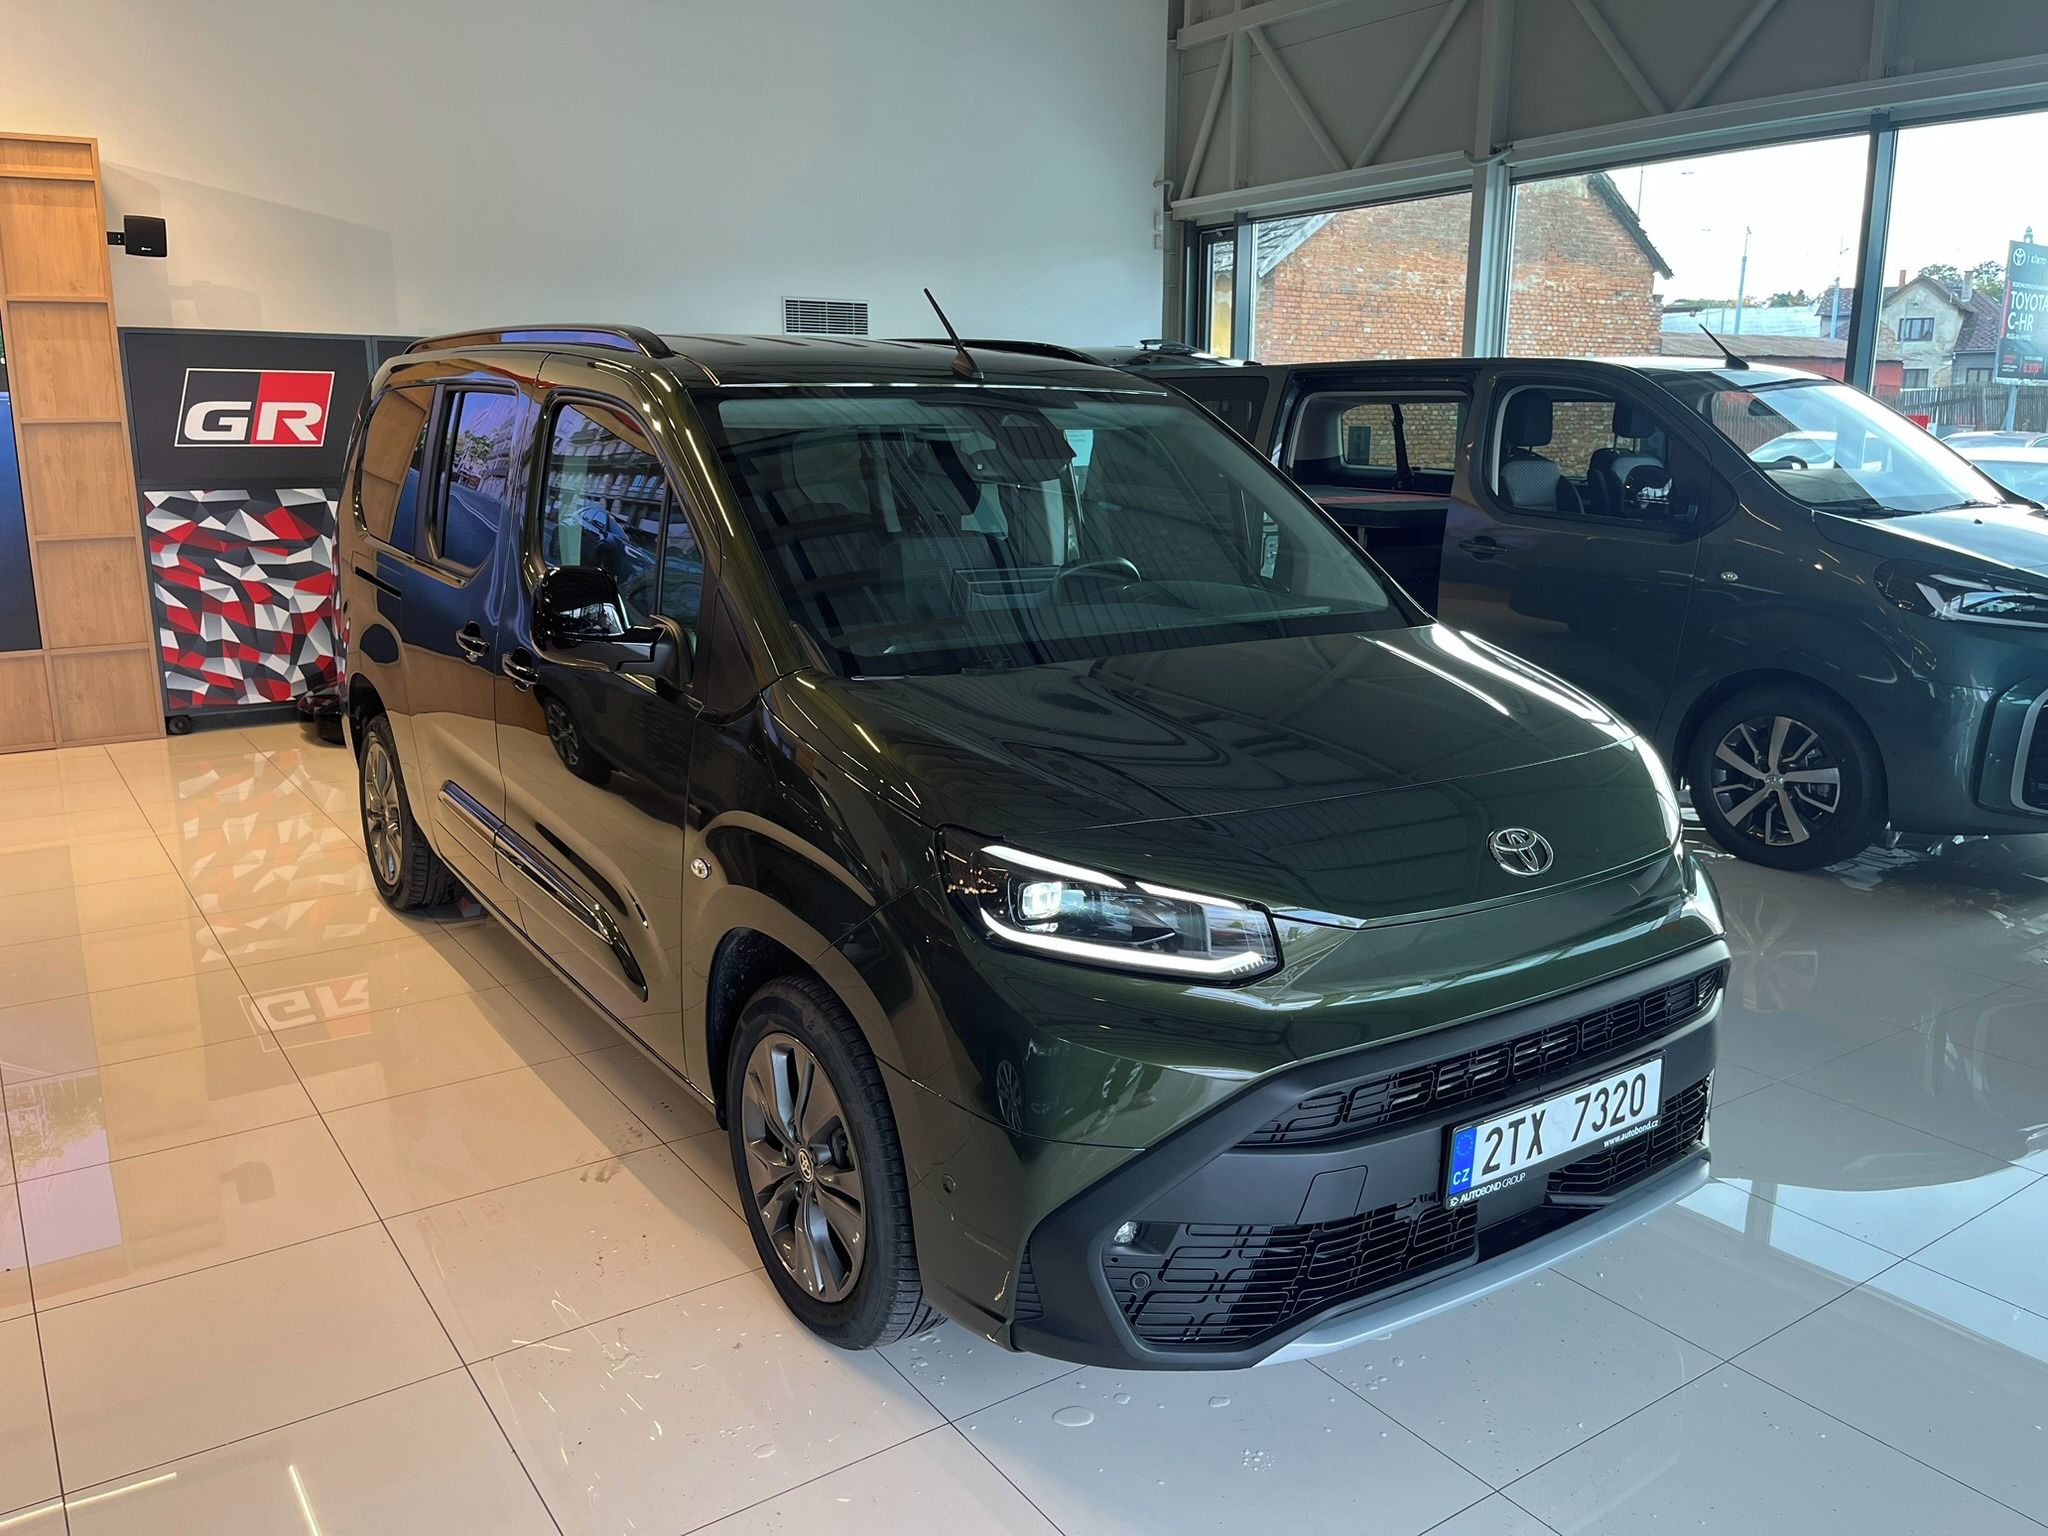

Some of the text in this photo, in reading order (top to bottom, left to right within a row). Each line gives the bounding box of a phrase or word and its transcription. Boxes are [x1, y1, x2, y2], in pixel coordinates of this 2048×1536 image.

[2010, 291, 2048, 312] TOYOTA
[2007, 313, 2033, 332] C-HR
[184, 401, 323, 441] GR
[1481, 1072, 1646, 1175] 2TX 7320
[1604, 1120, 1658, 1147] www.autobond.cz
[1453, 1167, 1470, 1186] CZ
[1460, 1172, 1525, 1203] AUTOBOND GROUP
